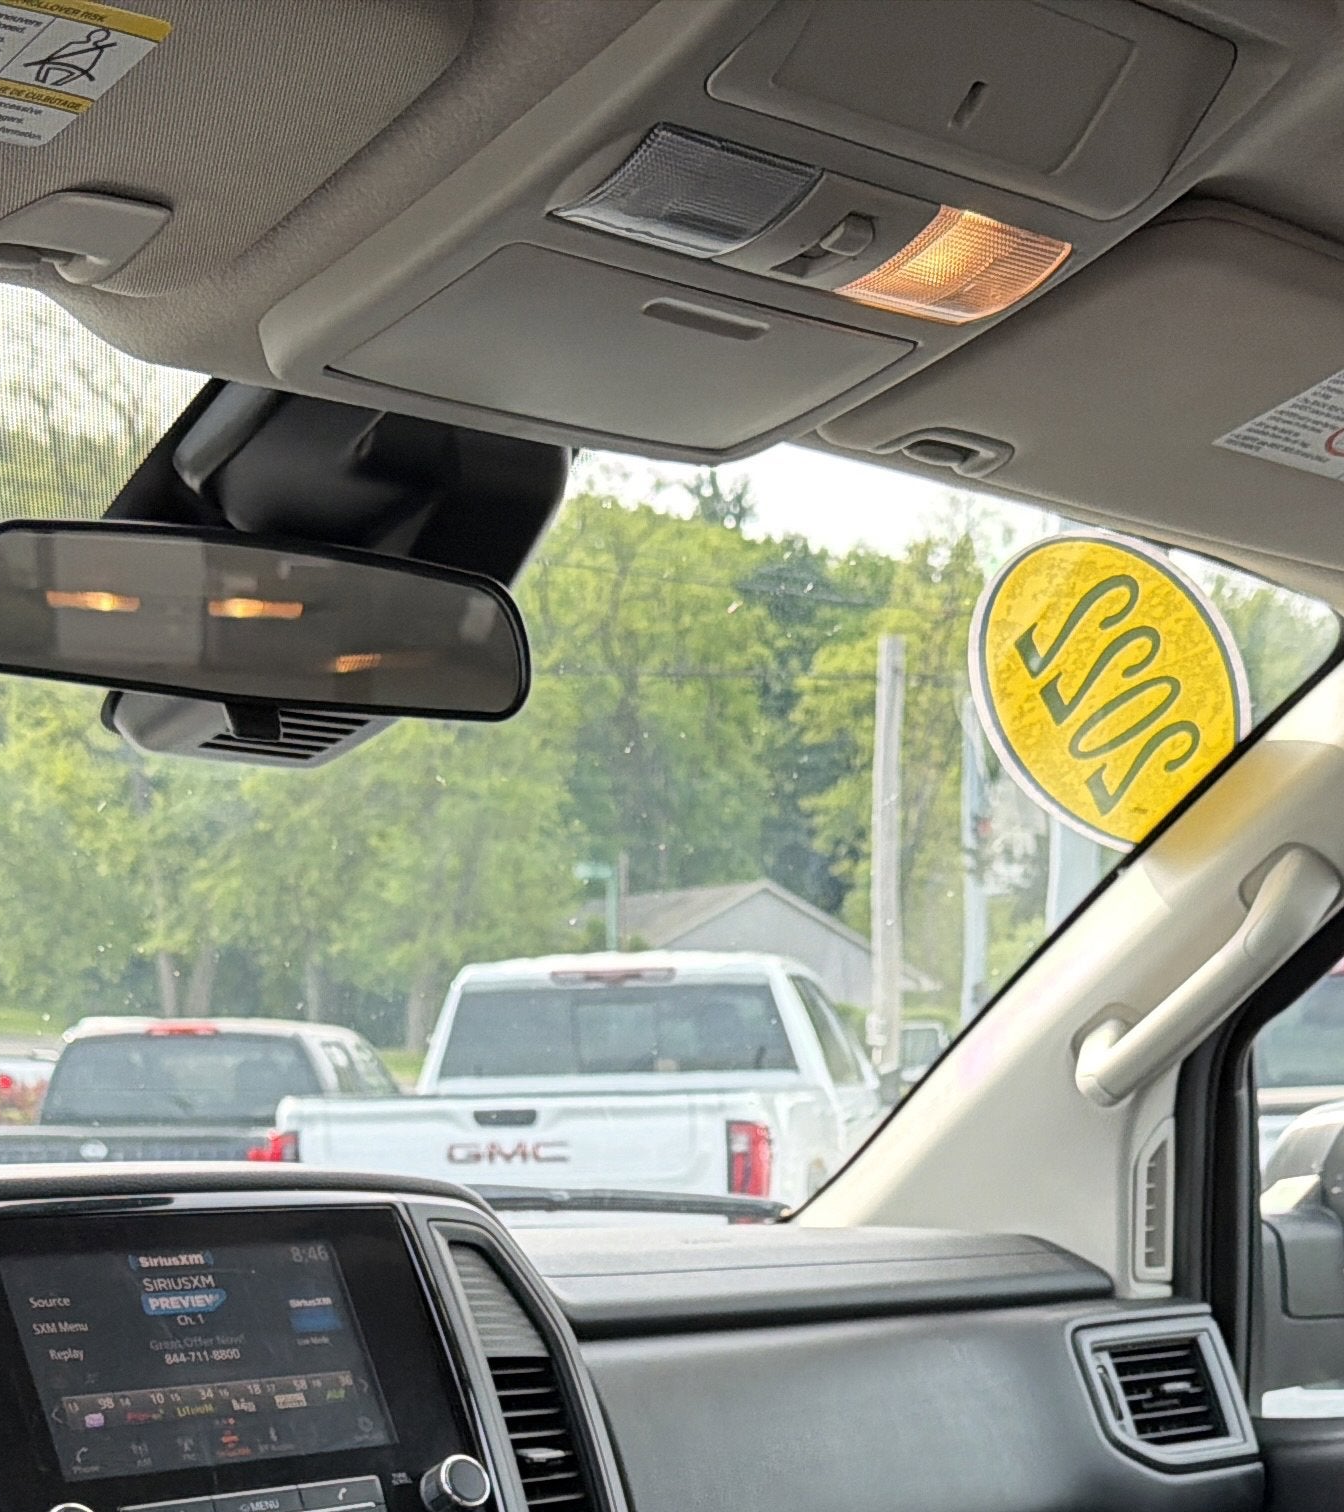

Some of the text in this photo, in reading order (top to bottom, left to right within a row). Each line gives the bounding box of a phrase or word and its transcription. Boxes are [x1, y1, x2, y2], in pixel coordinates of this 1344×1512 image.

[447, 1141, 570, 1164] GMC
[289, 1245, 330, 1263] 8:46
[142, 1274, 216, 1292] SIRIUSXM
[29, 1297, 71, 1309] Source
[148, 1293, 219, 1311] PREVIEW
[32, 1320, 89, 1335] SXM Menu
[49, 1347, 84, 1362] Replay
[150, 1391, 165, 1405] 10
[250, 1500, 280, 1512] MENU
